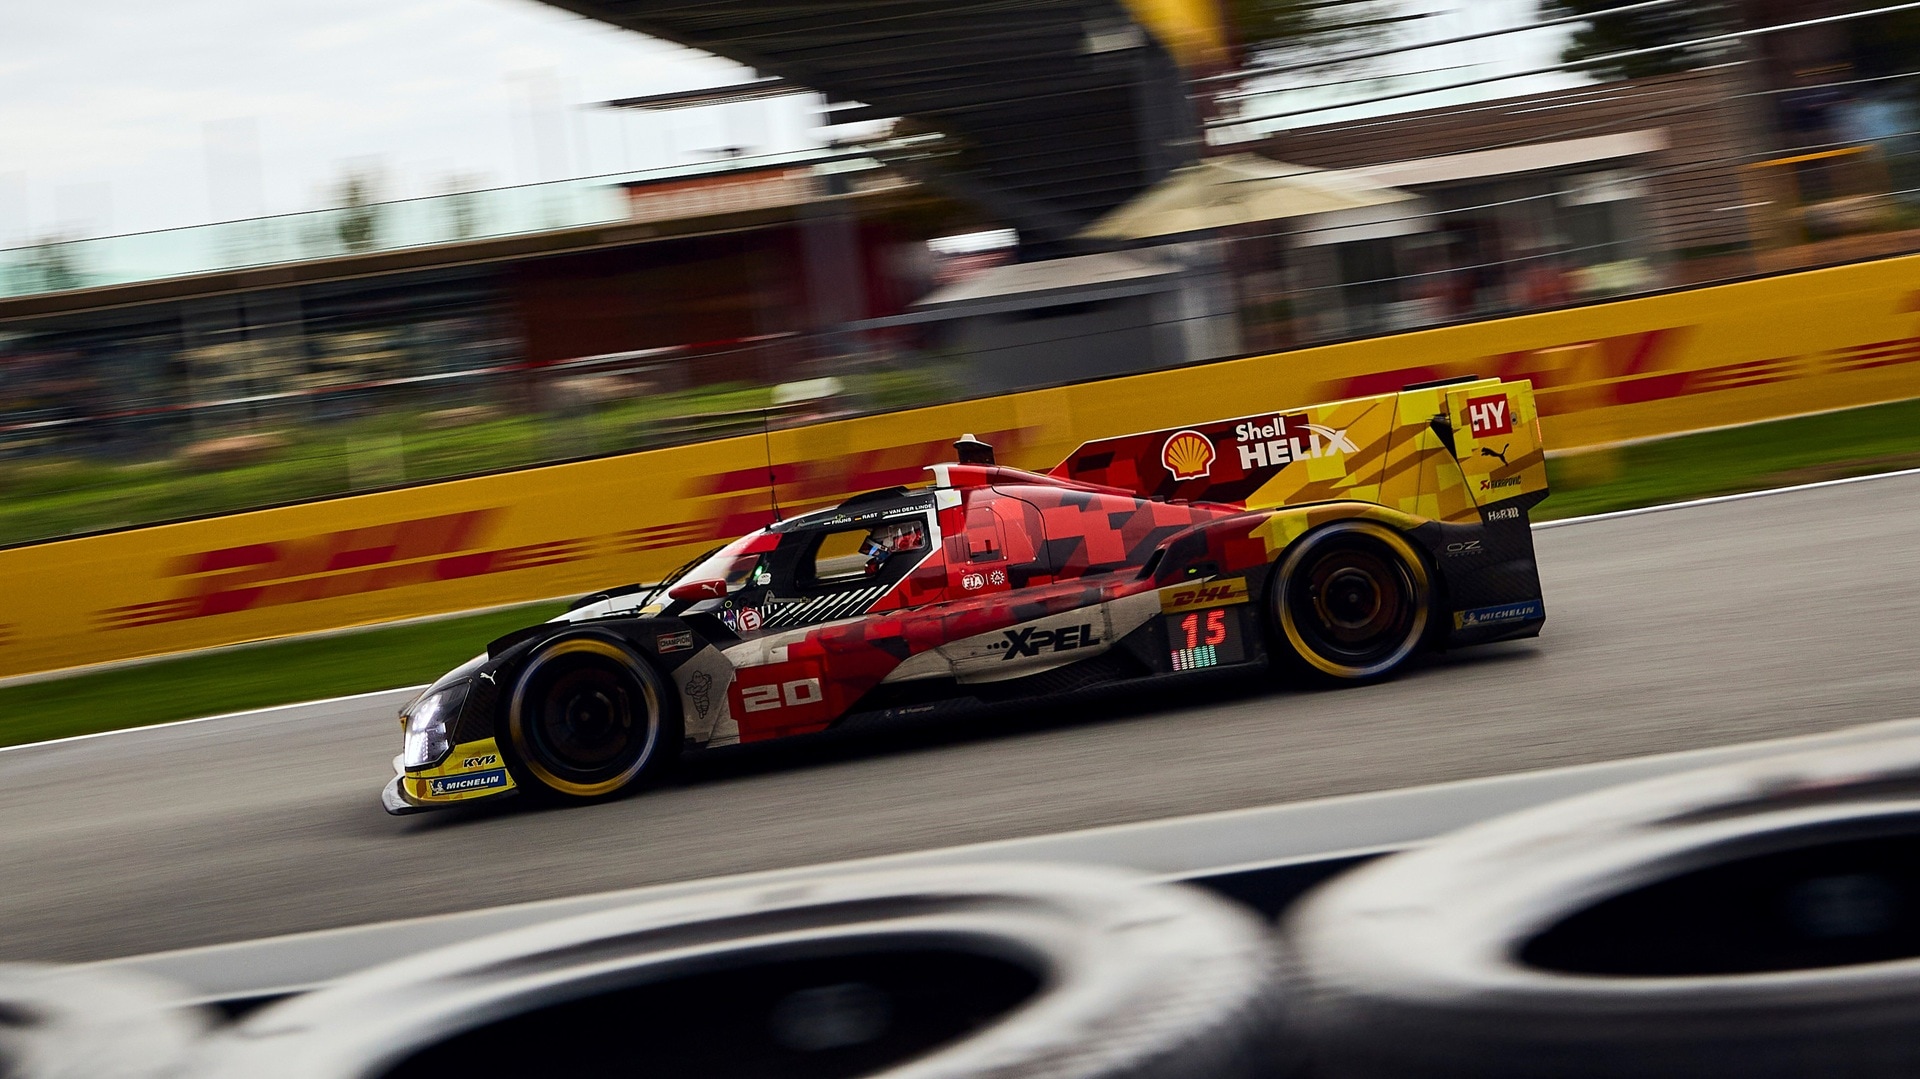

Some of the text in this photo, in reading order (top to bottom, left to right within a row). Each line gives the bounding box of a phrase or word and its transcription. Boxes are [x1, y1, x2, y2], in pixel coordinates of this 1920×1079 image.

[1469, 400, 1506, 432] HY
[1235, 417, 1287, 442] Shell
[1236, 429, 1360, 470] HELIX
[862, 512, 878, 520] RAST
[915, 503, 932, 511] LINDE
[963, 575, 983, 589] FIA
[1172, 584, 1236, 607] DHL
[743, 612, 758, 629] E
[1480, 606, 1535, 621] MICHELIN
[1181, 609, 1227, 649] 15
[660, 635, 691, 647] CHAMPION
[1002, 623, 1100, 661] XPEL
[741, 678, 823, 713] 20
[463, 754, 497, 768] KYB
[446, 775, 499, 790] MICHELIN
